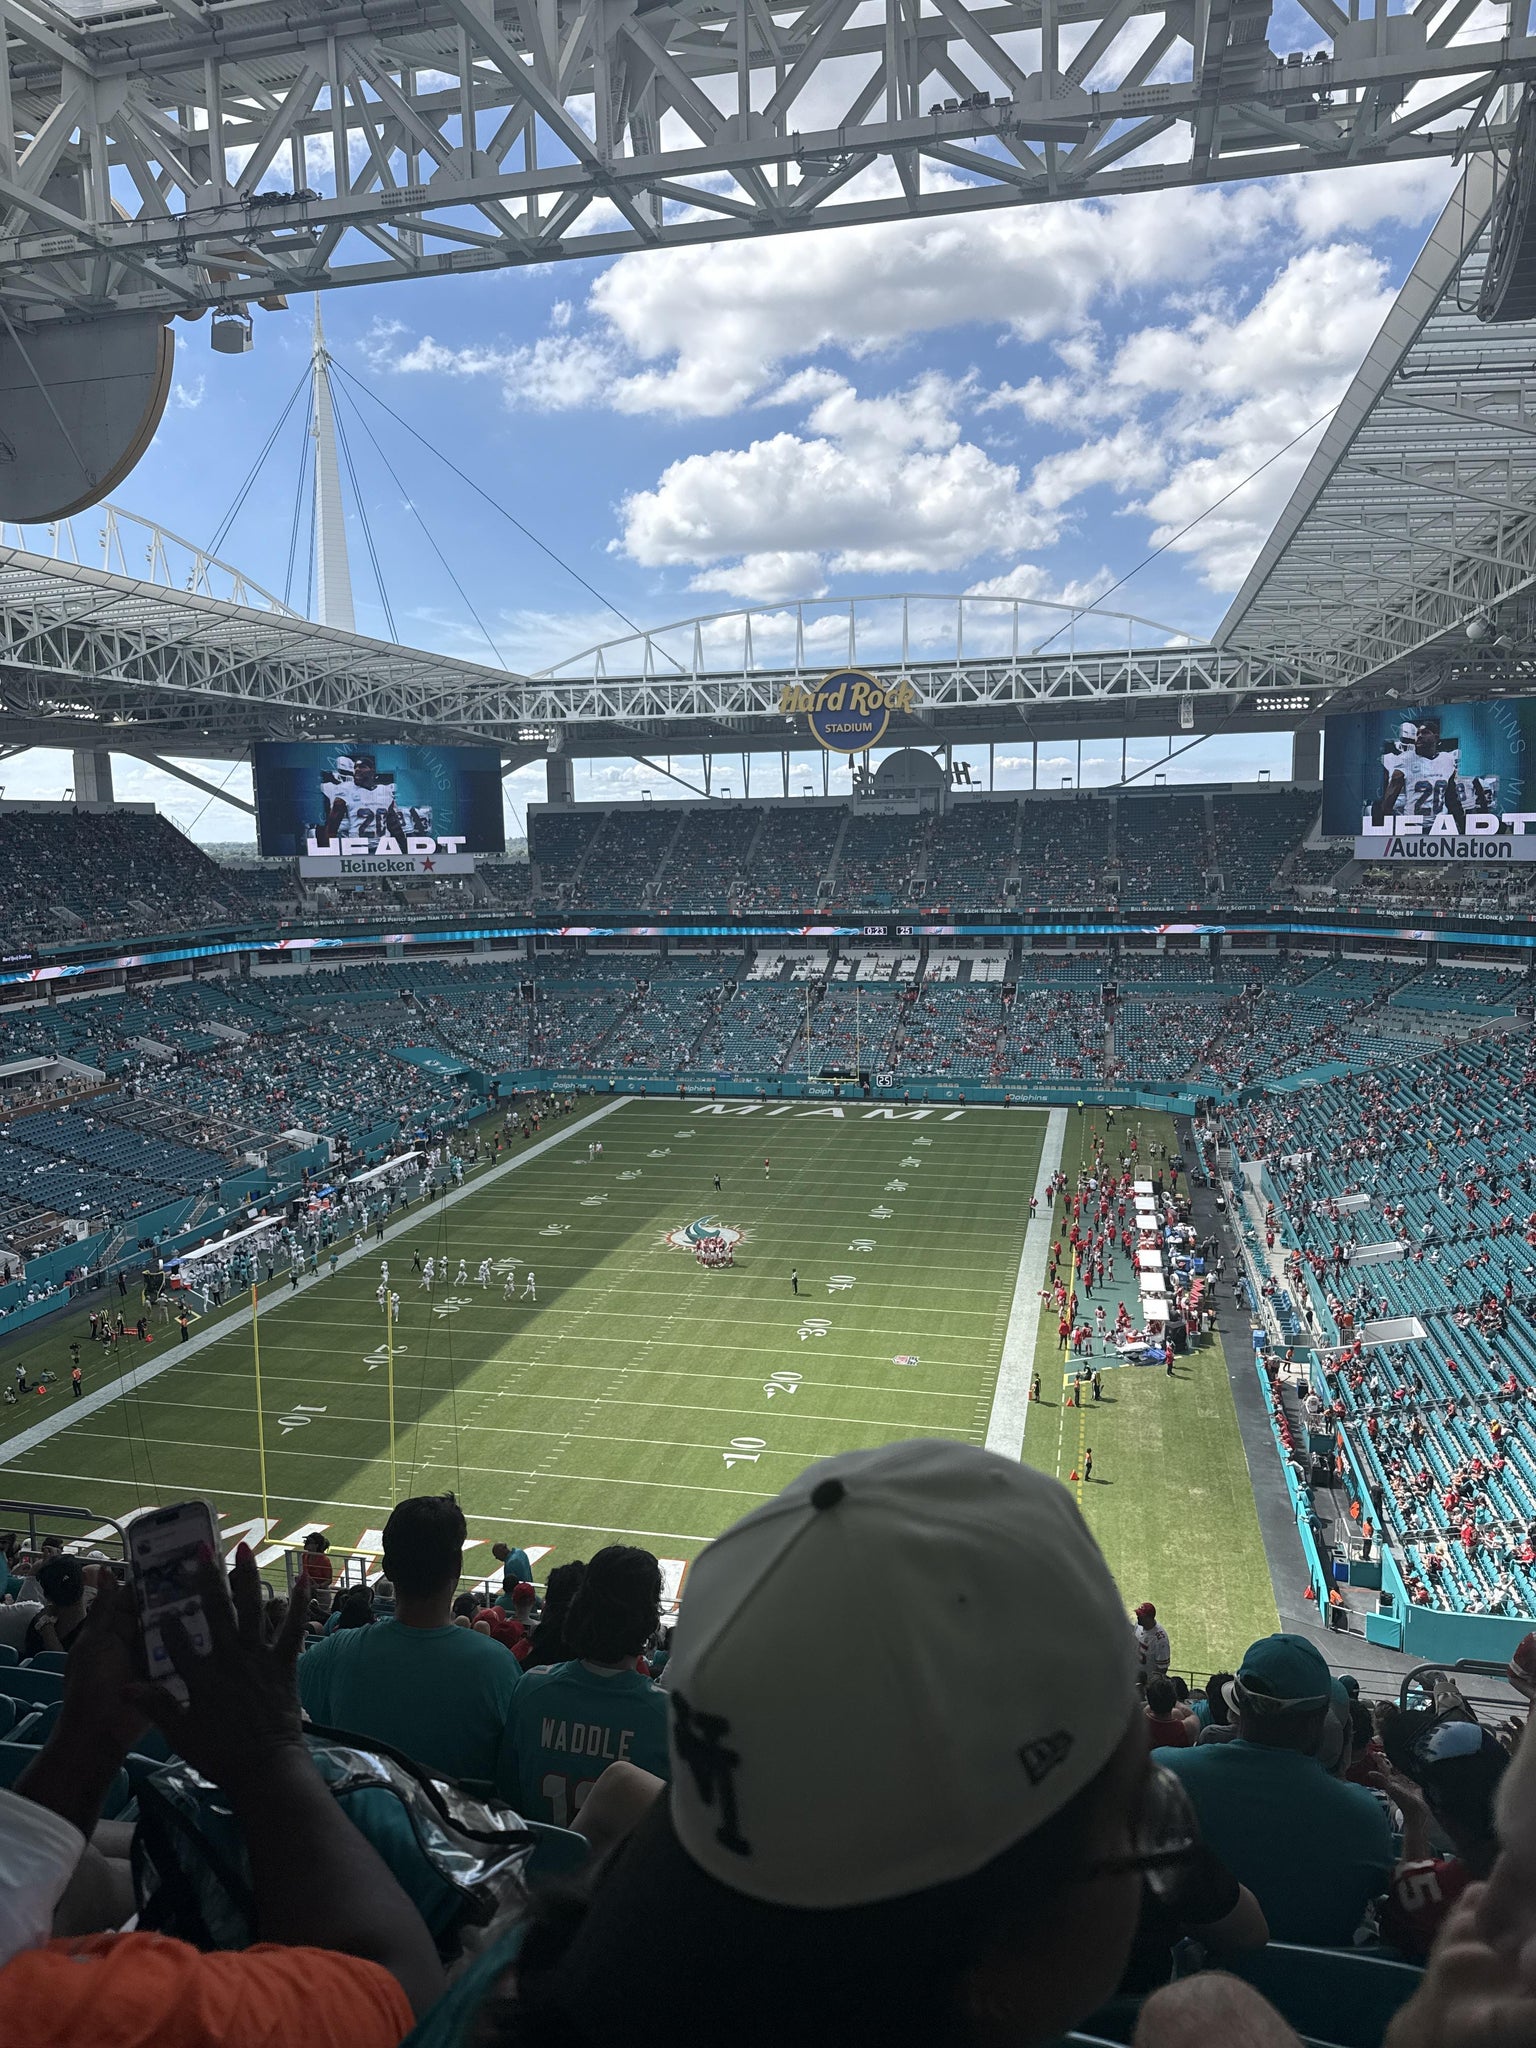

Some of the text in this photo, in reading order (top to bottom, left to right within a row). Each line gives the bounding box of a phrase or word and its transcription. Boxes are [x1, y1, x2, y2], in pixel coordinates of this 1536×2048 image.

[779, 680, 915, 716] Hard Rock
[825, 722, 872, 733] STADIUM
[1390, 838, 1512, 858] AutoNation
[340, 858, 415, 873] Heineken
[676, 1084, 711, 1093] Dlphins
[878, 1076, 890, 1086] 25
[1009, 1093, 1048, 1103] Dolphins
[689, 1104, 966, 1121] MIAMI
[848, 1239, 877, 1252] 50
[825, 1275, 856, 1290] 40
[797, 1318, 832, 1337] 30
[363, 1344, 408, 1365] 20
[763, 1371, 803, 1395] 20
[277, 1404, 328, 1427] 10
[722, 1437, 767, 1464] 10
[540, 1717, 635, 1762] WADDLE
